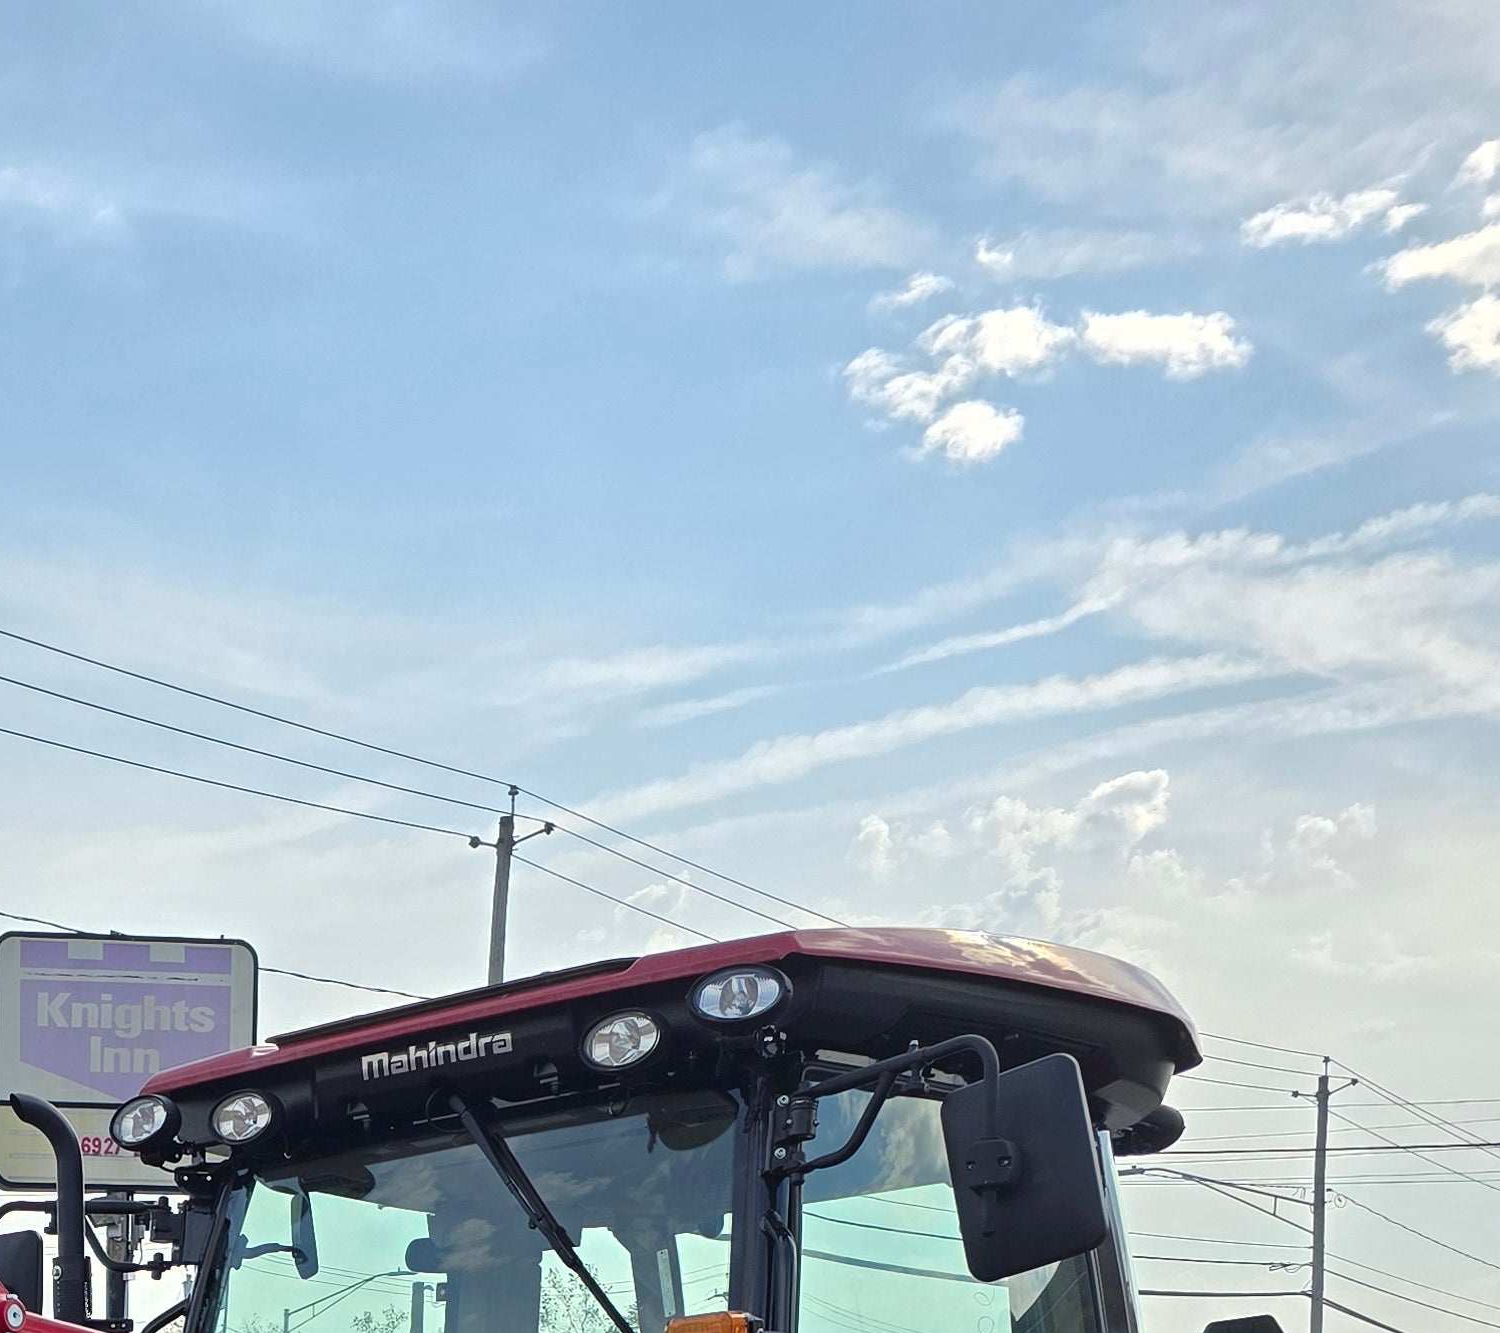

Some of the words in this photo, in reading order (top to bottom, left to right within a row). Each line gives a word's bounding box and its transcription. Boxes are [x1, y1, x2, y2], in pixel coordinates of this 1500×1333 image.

[37, 992, 215, 1039] Knights
[90, 1036, 160, 1073] Inn
[361, 1032, 513, 1081] Mahindra
